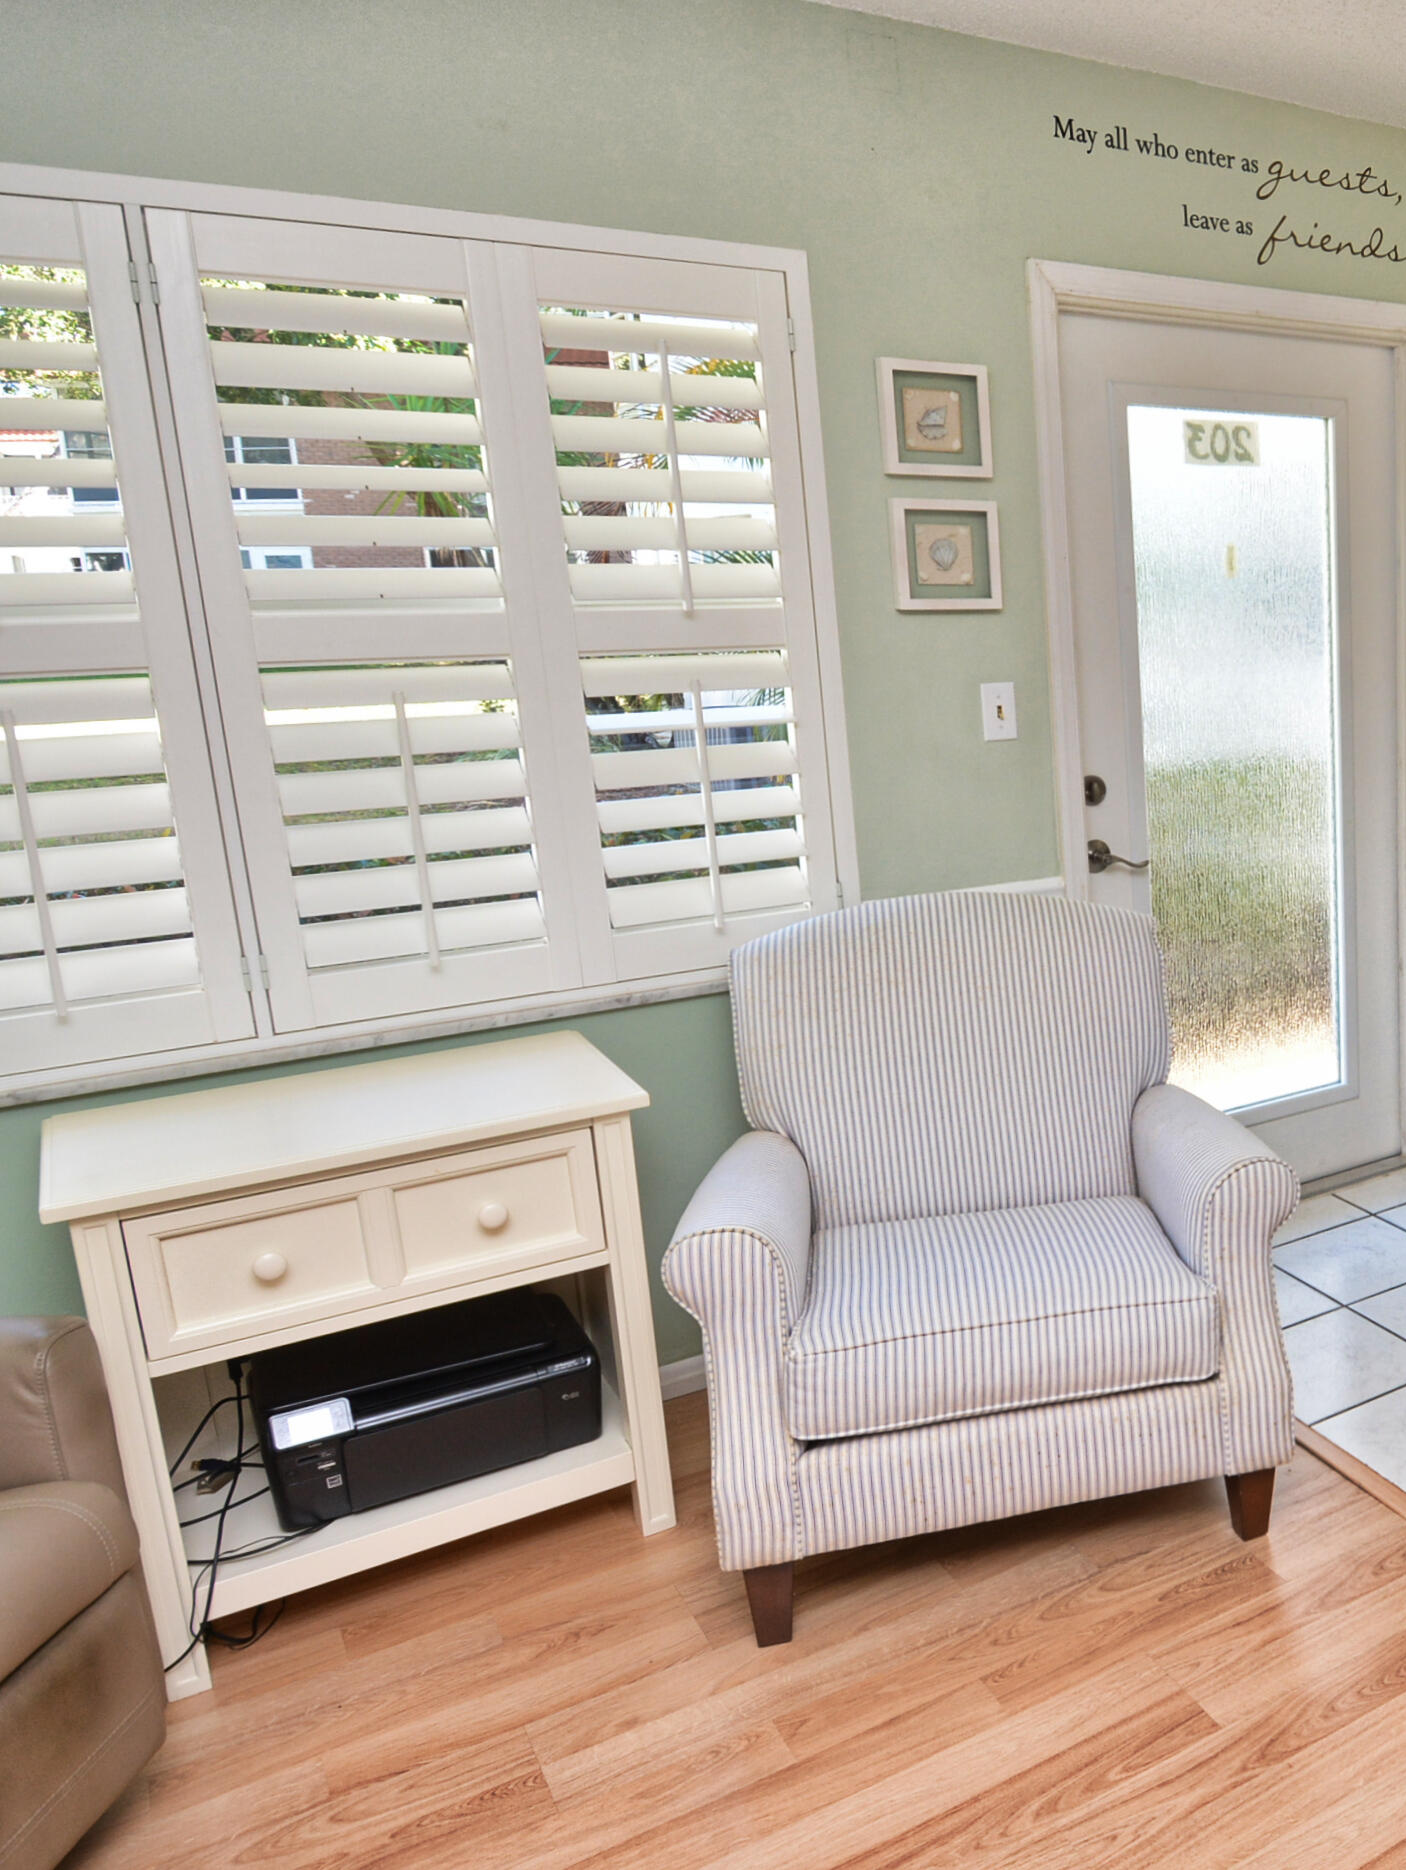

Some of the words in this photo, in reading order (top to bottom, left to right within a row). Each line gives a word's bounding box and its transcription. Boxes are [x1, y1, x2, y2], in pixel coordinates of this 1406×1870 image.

[1053, 115, 1098, 154] May
[1104, 126, 1129, 151] all
[1135, 133, 1179, 160] who
[1185, 147, 1236, 170] enter
[1241, 157, 1260, 174] as
[1256, 160, 1403, 207] guests,
[1182, 204, 1231, 233] leave
[1235, 219, 1254, 236] as
